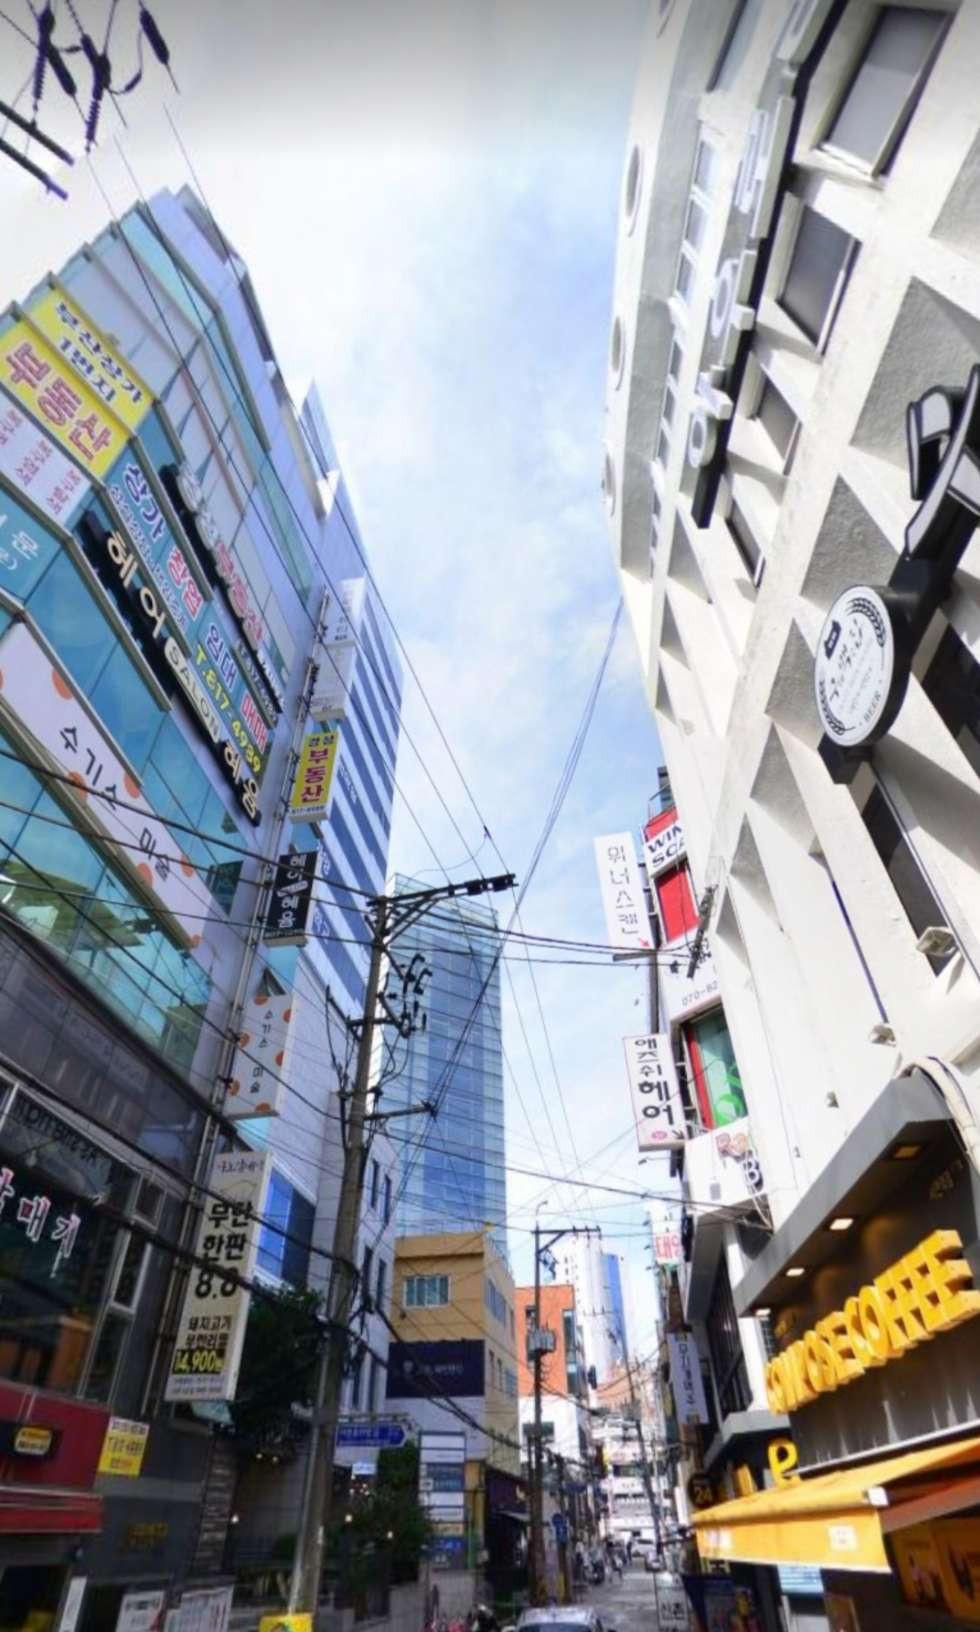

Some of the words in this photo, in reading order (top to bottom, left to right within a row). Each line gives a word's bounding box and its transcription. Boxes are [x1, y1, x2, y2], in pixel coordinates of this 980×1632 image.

[5, 341, 113, 461] 부동산
[107, 531, 166, 639] 헤어
[168, 640, 222, 744] SALON
[122, 462, 166, 543] 상가
[206, 624, 239, 688] 임대
[300, 749, 329, 803] 부동산
